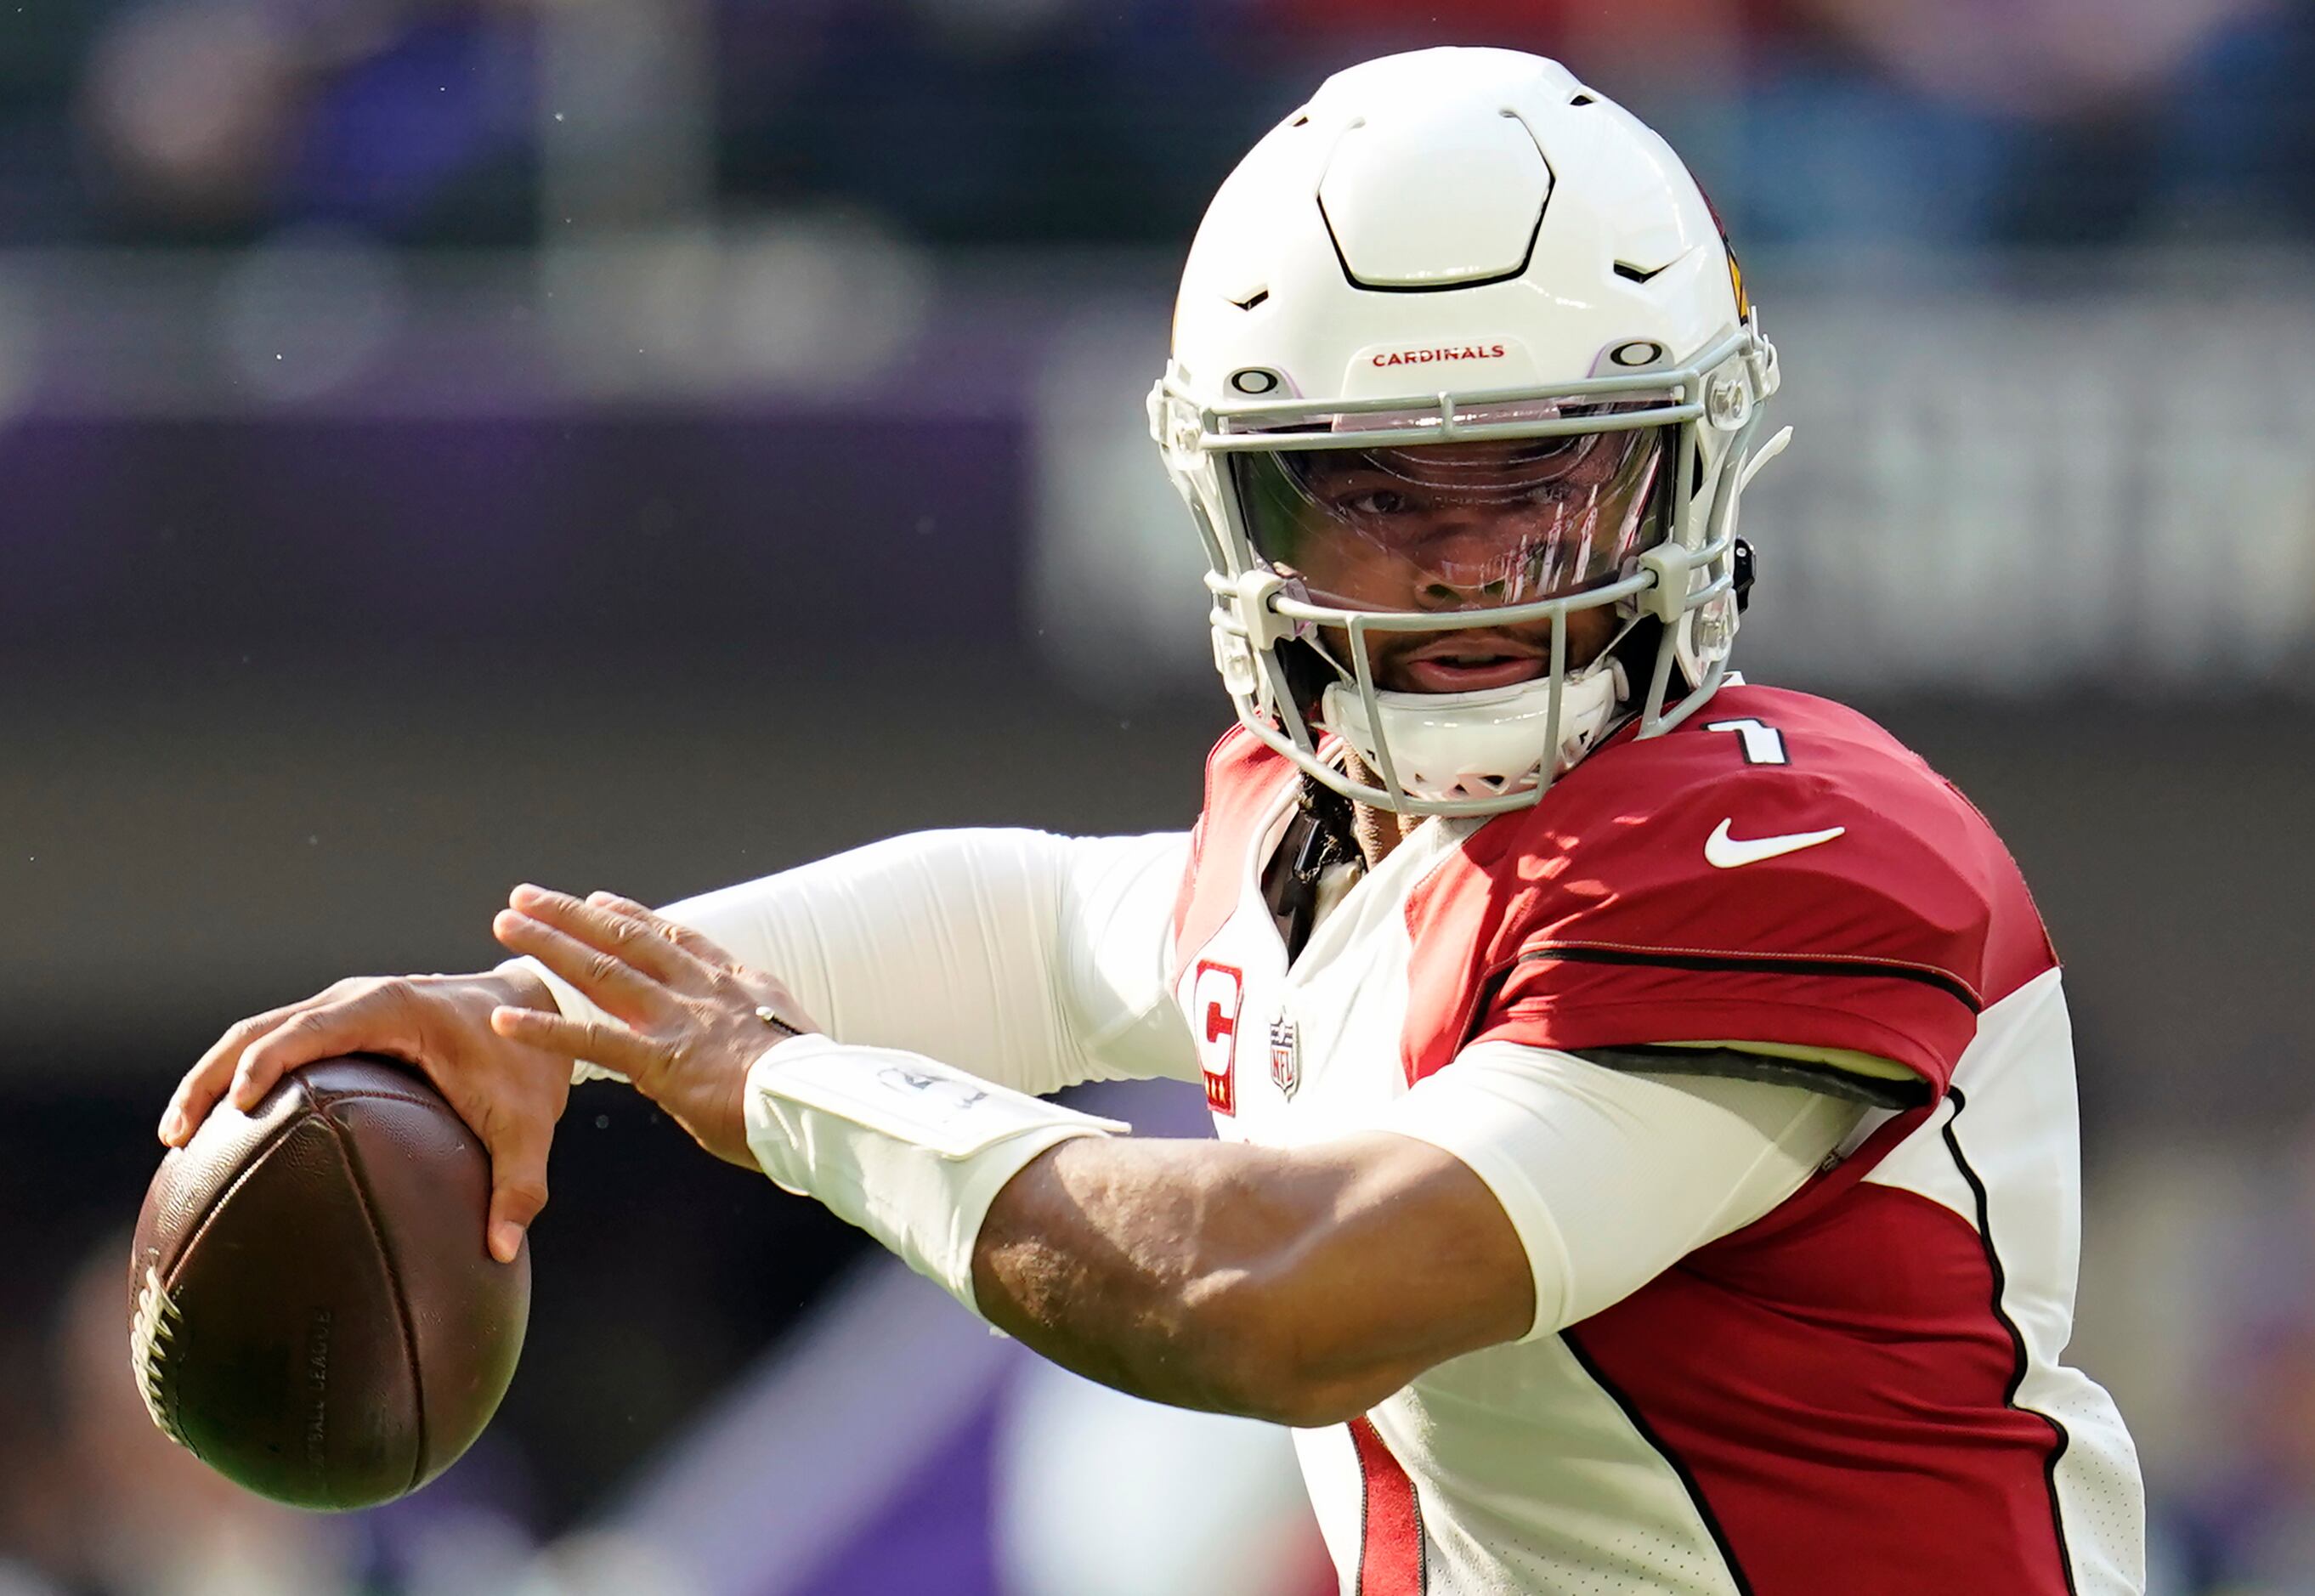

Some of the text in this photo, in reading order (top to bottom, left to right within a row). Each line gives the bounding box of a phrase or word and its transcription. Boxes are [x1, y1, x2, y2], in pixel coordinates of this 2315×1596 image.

[1373, 344, 1505, 368] CARDINALS
[1701, 717, 1791, 765] 1
[1272, 1048, 1293, 1084] NFL
